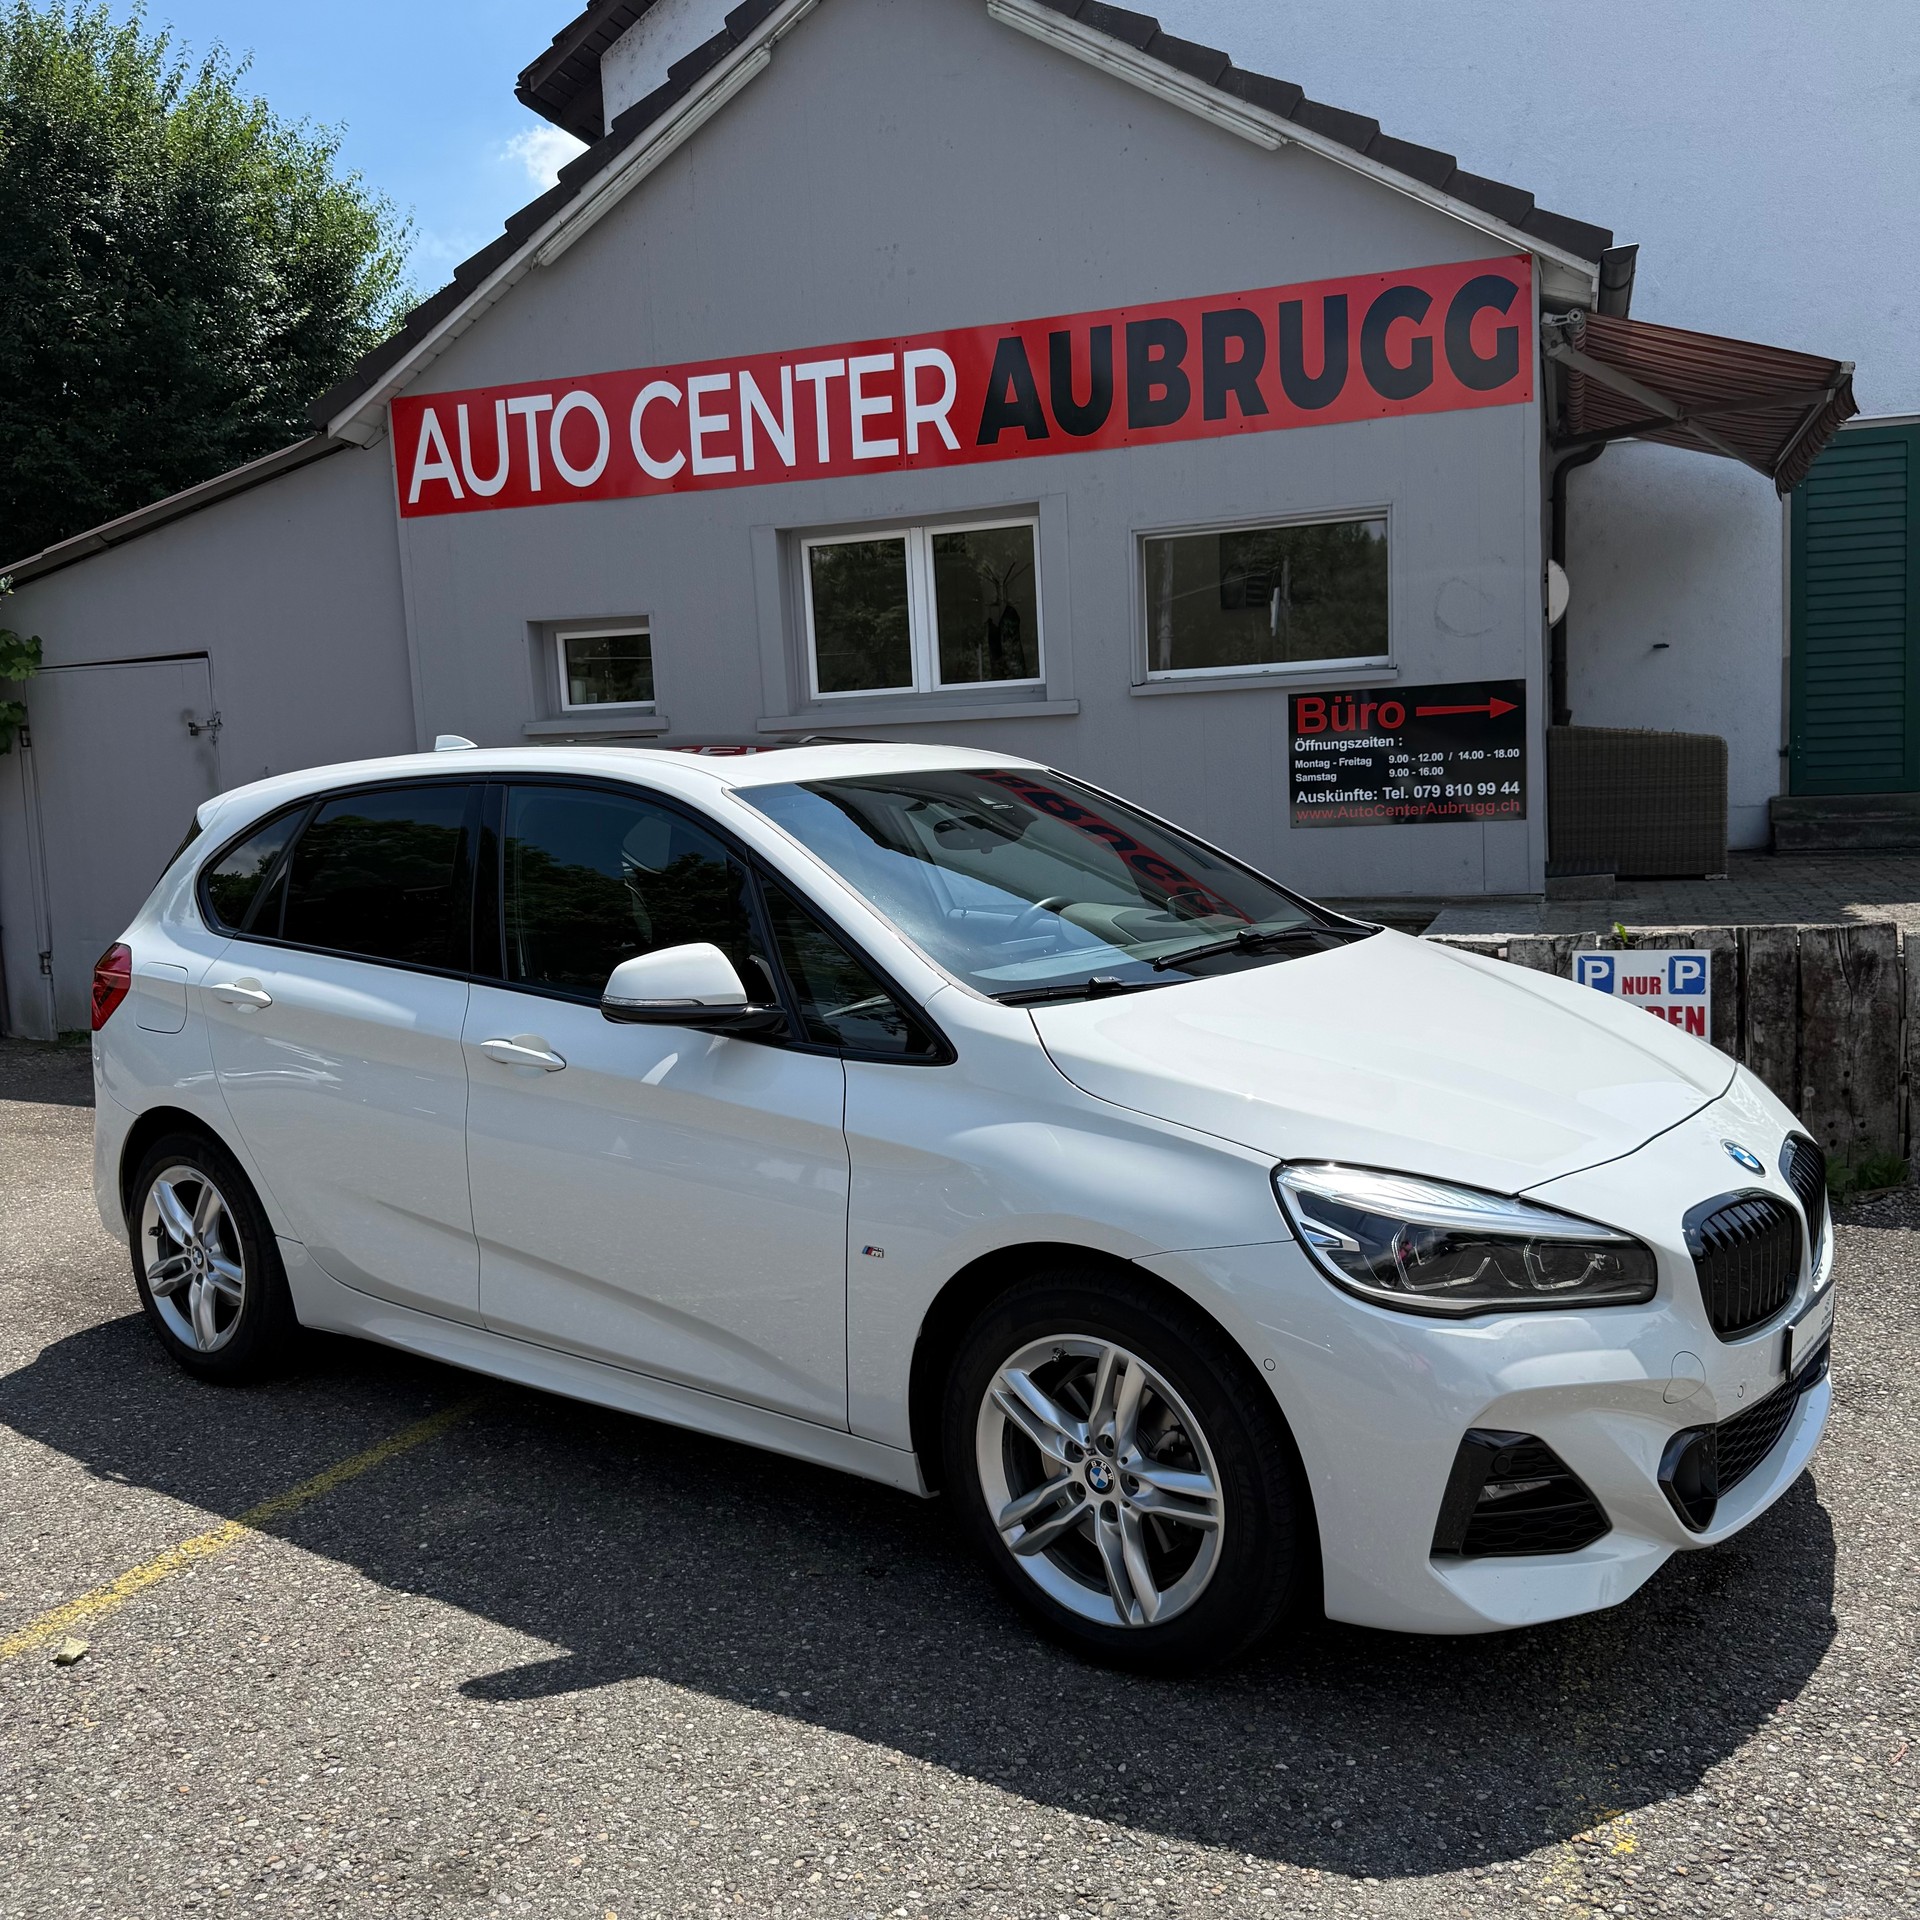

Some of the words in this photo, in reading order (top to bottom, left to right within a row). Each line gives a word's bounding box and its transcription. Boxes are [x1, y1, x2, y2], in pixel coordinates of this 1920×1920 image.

[408, 390, 610, 504] AUTO
[630, 347, 960, 480] CENTER
[976, 274, 1520, 446] AUBRUGG
[1297, 696, 1406, 734] Büro
[1295, 736, 1394, 752] Öffnungszeiten
[1295, 760, 1330, 769] Montag
[1339, 757, 1372, 767] Freitag
[1388, 754, 1409, 764] 9.00
[1418, 752, 1444, 762] 12.00
[1458, 750, 1484, 760] 14.00
[1493, 748, 1520, 758] 18.00
[1295, 773, 1337, 783] Samstag
[1389, 768, 1409, 777] 9.00
[1418, 766, 1444, 776] 16.00
[1296, 788, 1378, 803] Auskünfte:
[1382, 785, 1409, 799] Tel.
[1413, 785, 1441, 798] 079
[1445, 783, 1473, 796] 810
[1477, 782, 1496, 795] 99
[1500, 781, 1520, 794] 44
[1296, 799, 1520, 820] www.AutoCenterAubrugg.ch
[1622, 976, 1661, 995] NUR
